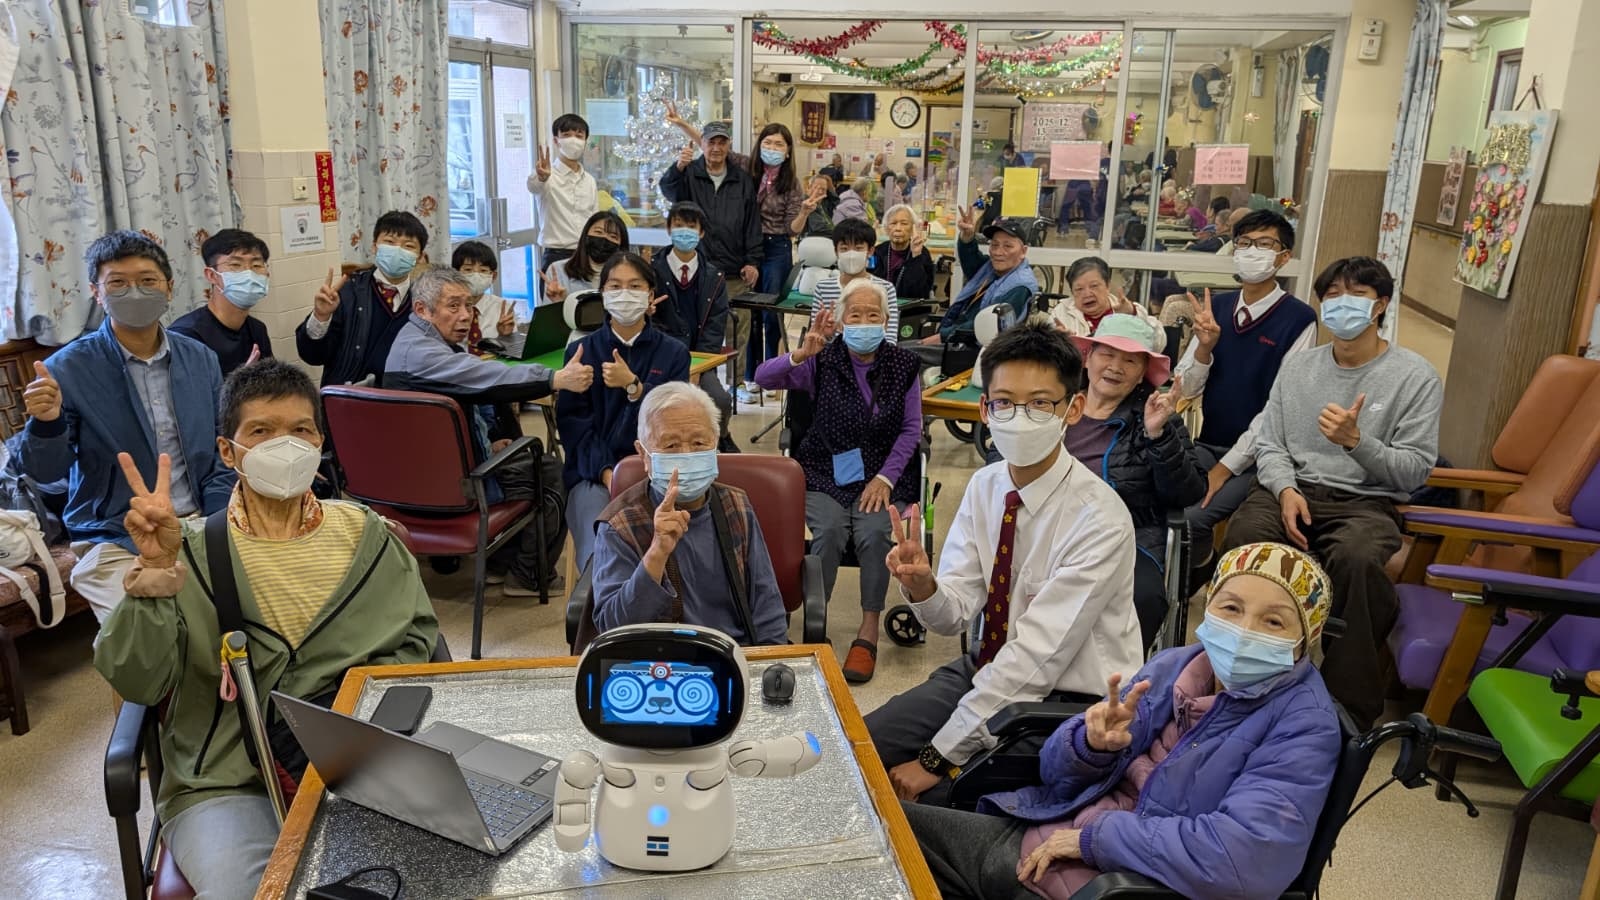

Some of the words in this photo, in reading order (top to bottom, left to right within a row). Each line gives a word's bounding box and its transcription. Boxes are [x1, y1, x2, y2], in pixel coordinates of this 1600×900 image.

[1033, 118, 1054, 127] 2025
[1059, 118, 1068, 127] 12
[1037, 127, 1046, 136] 13
